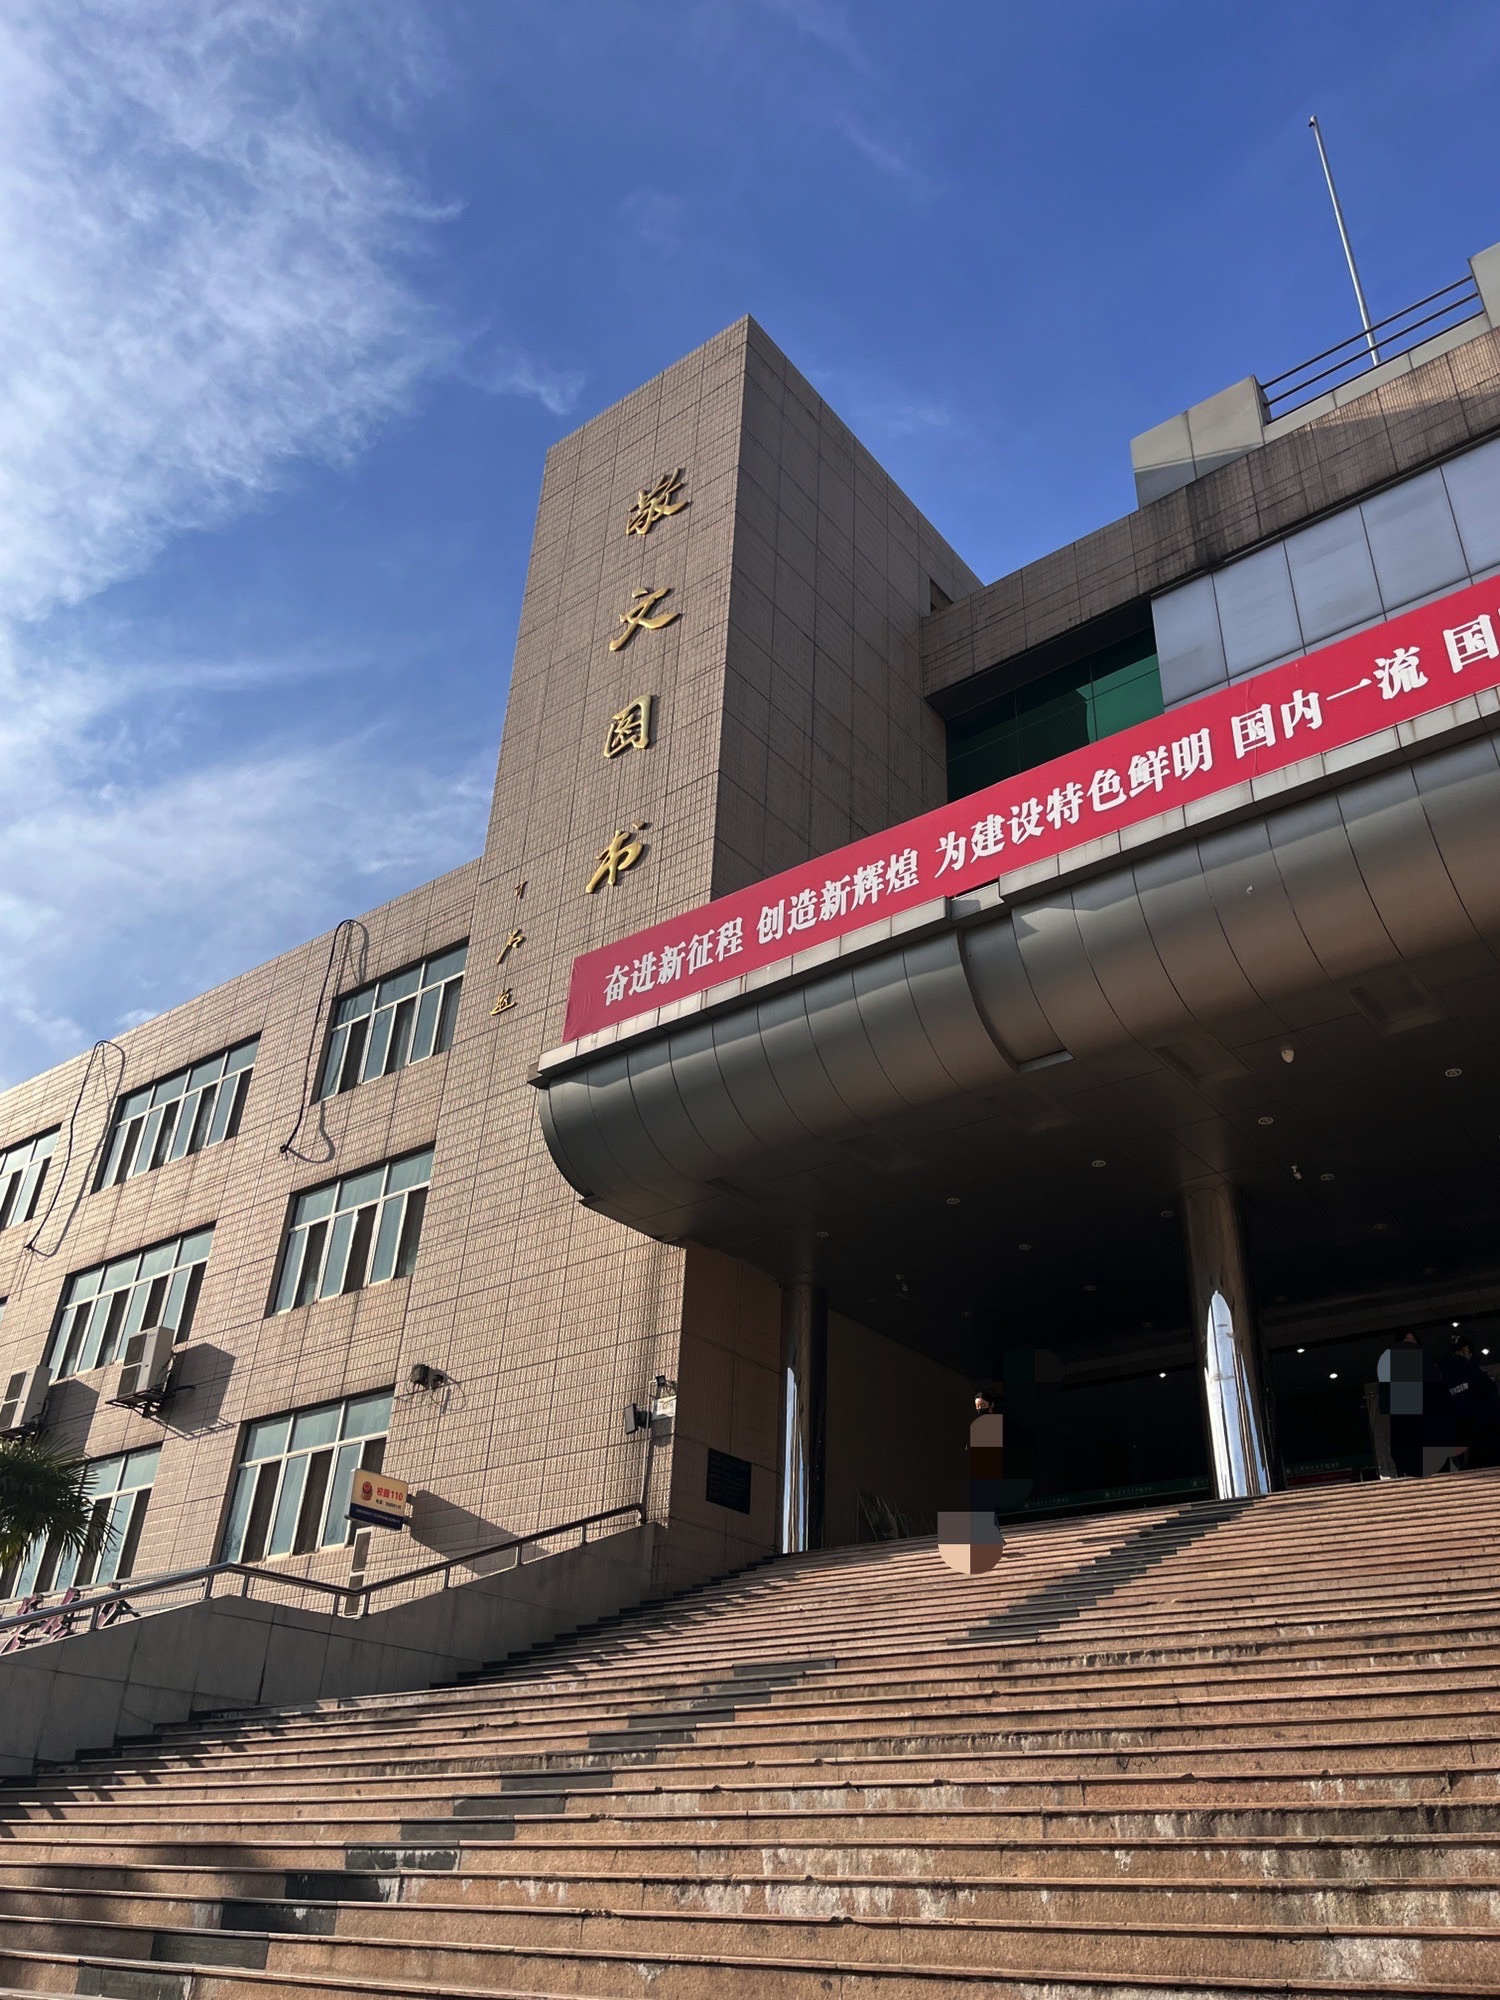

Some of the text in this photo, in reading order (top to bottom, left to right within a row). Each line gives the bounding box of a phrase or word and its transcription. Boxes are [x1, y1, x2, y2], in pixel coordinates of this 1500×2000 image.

[603, 608, 1500, 1006] 奋进新征程 创造新辉煌 为建设特色鲜明 国内一流 国
